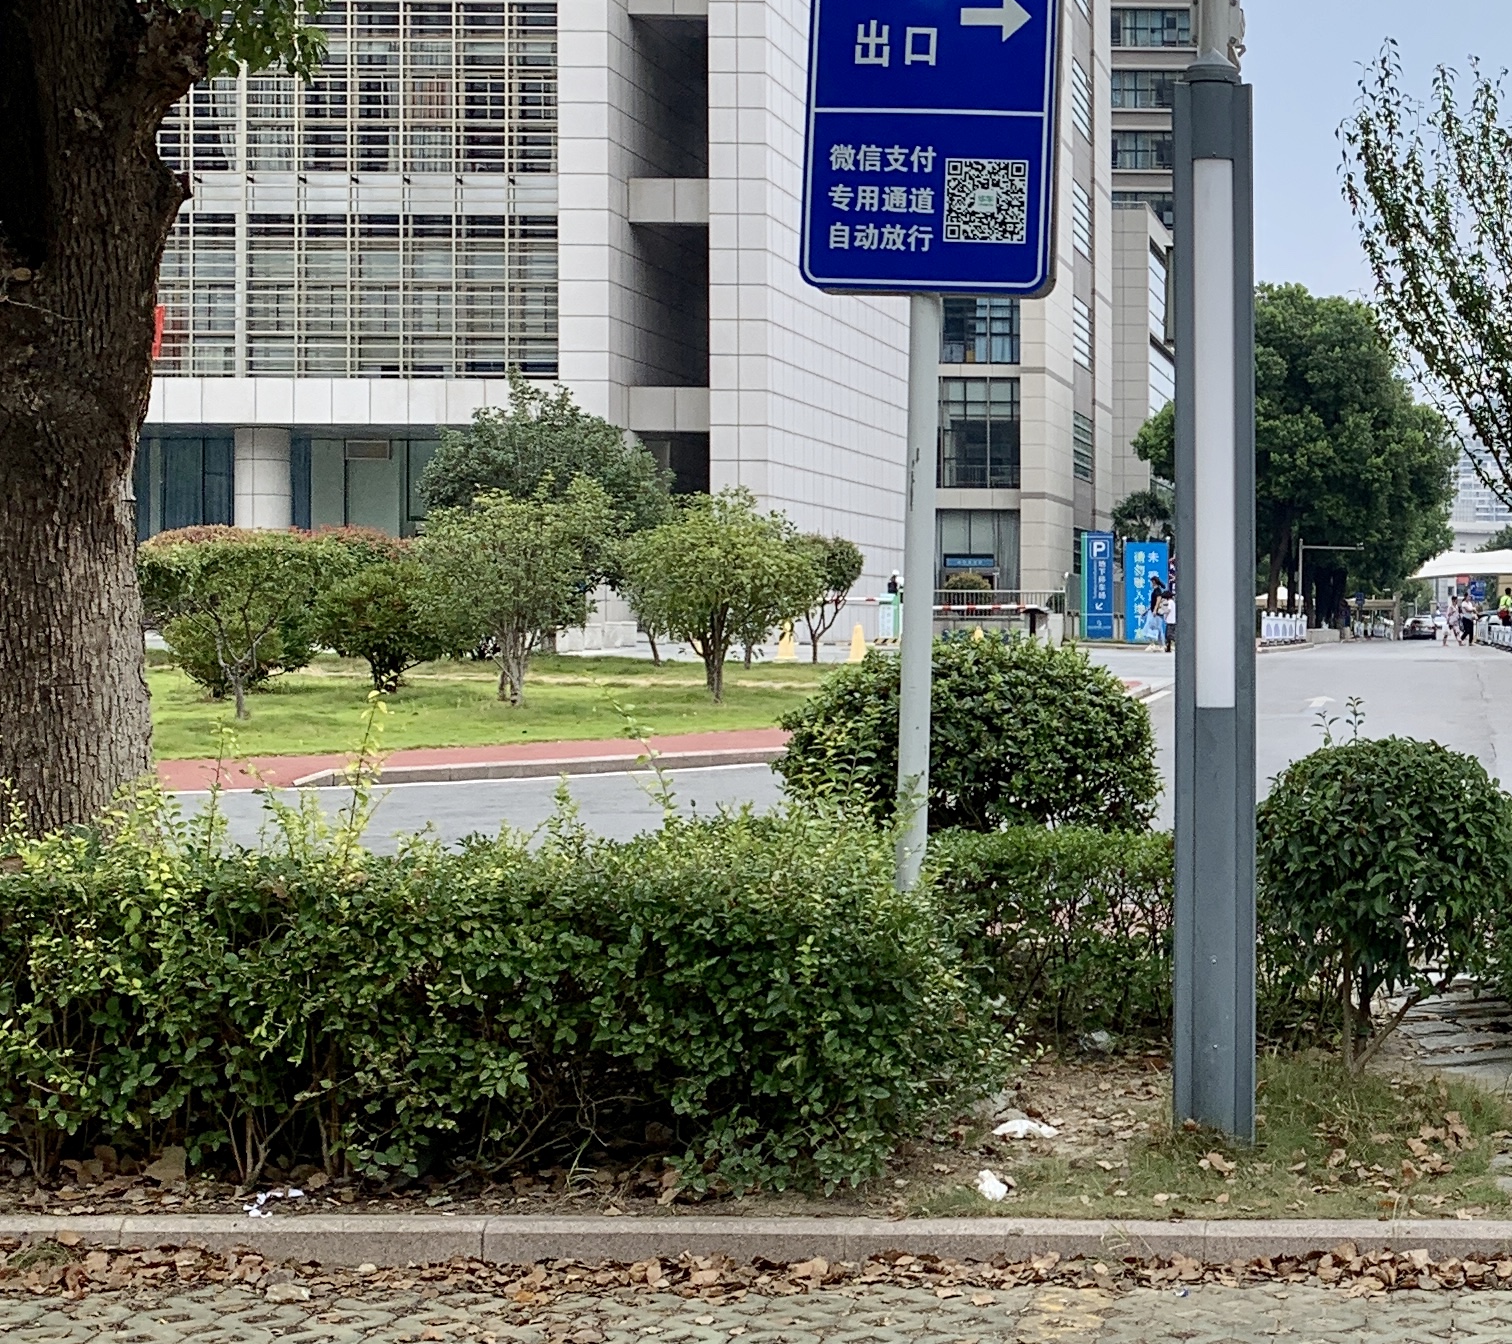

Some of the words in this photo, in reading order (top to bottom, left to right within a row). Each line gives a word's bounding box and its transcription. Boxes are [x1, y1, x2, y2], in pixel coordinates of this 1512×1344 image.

[854, 20, 938, 68] 出口
[829, 144, 937, 173] 微信支付
[828, 184, 935, 215] 专用通道
[828, 222, 934, 252] 自动放行
[1093, 542, 1106, 558] P
